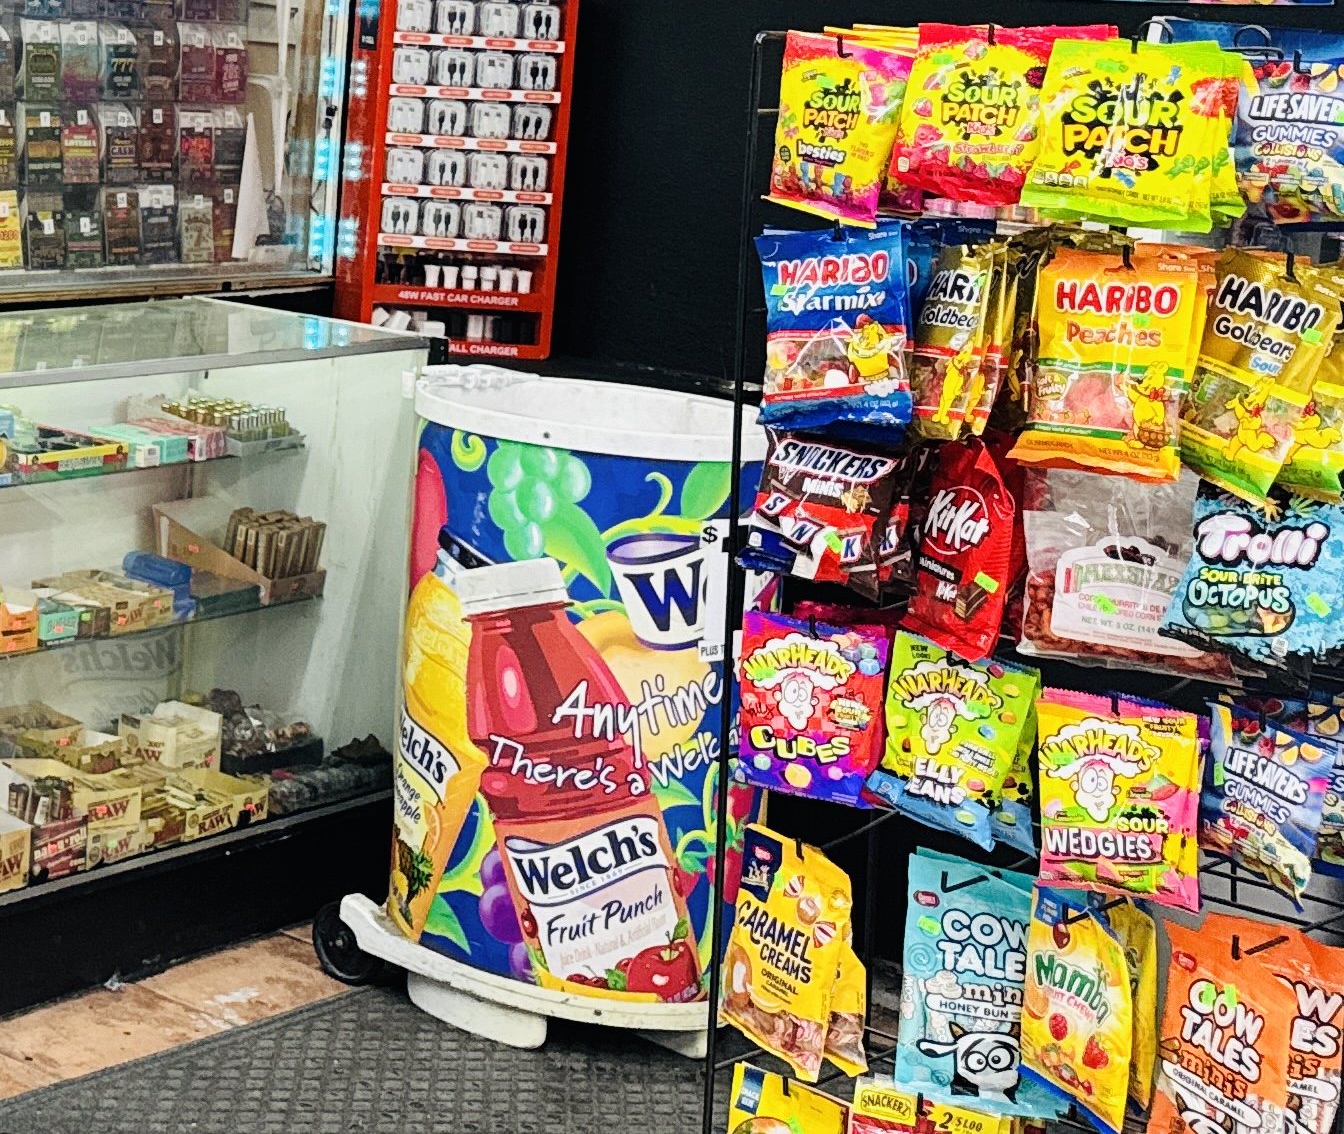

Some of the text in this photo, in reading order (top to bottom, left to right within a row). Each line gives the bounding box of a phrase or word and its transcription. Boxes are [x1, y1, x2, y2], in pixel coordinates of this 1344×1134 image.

[811, 89, 861, 111] SOUR
[948, 82, 1018, 107] SOUR
[804, 109, 858, 129] PATCH
[943, 103, 1016, 126] PATCH
[1064, 125, 1180, 156] PATCH
[1252, 125, 1337, 146] GUMMIES
[798, 141, 845, 162] besties
[778, 251, 889, 286] HARIBO
[421, 292, 518, 306] FAST CAR CHARGER
[780, 286, 885, 312] Starmix
[1066, 320, 1162, 346] Peaches
[775, 439, 892, 480] SNICKERS
[802, 477, 844, 498] MINIS
[1197, 513, 1329, 564] Trolli
[1187, 582, 1291, 612] OCTOPUS
[552, 671, 725, 769] Anytime
[750, 726, 850, 762] CUBES
[628, 773, 645, 796] a
[1117, 816, 1168, 834] SOUR
[1045, 828, 1154, 858] WEDGIES
[570, 881, 597, 896] SINCE
[547, 916, 595, 946] Fruit
[603, 884, 663, 926] Punch
[738, 900, 812, 964] CARAMEL
[760, 944, 812, 984] CREAMS
[761, 968, 799, 994] ORIGINAL
[939, 1000, 1009, 1018] HONEY BUN
[1181, 1008, 1261, 1083] TALES
